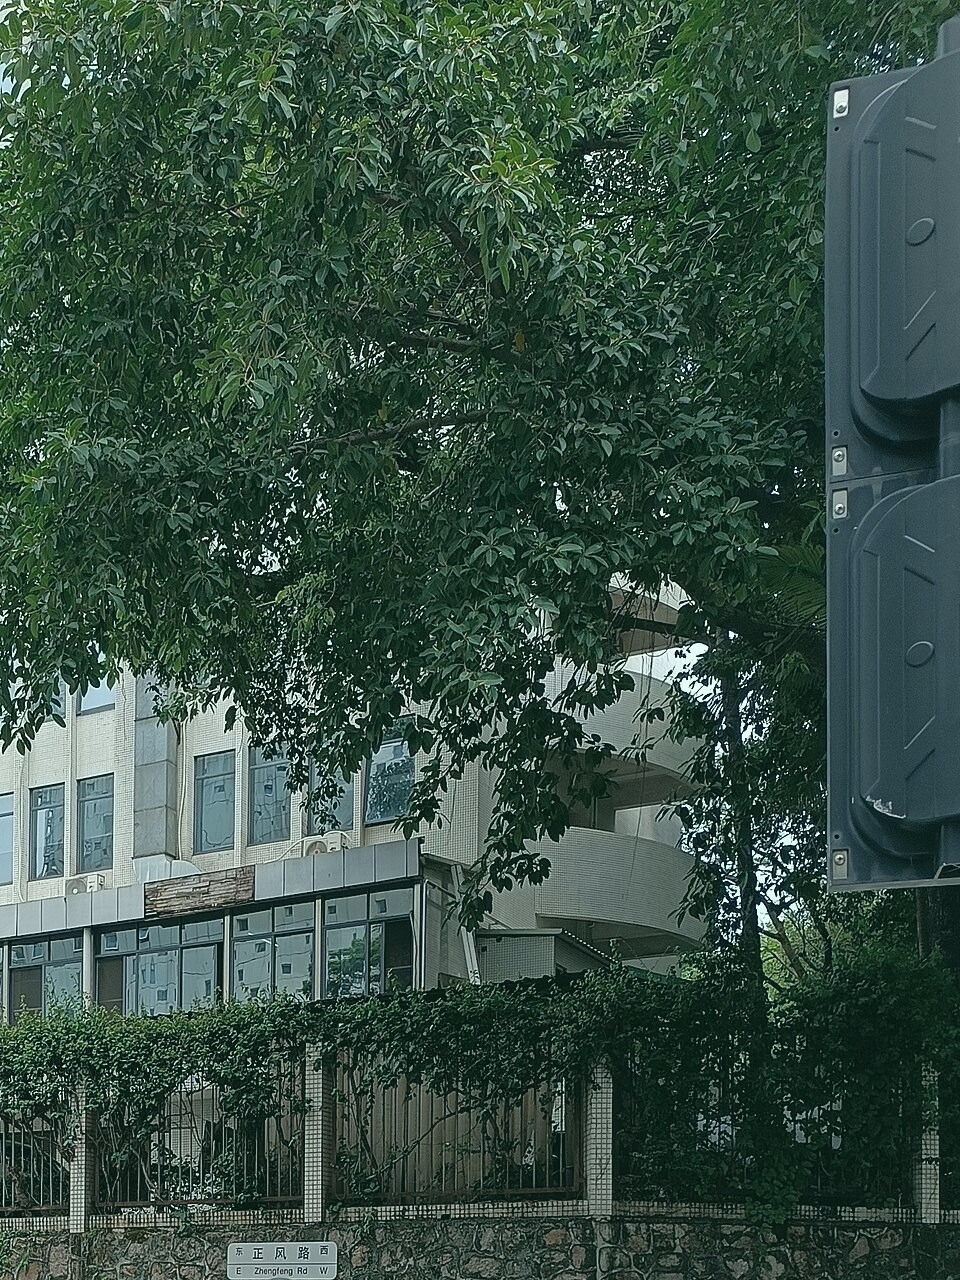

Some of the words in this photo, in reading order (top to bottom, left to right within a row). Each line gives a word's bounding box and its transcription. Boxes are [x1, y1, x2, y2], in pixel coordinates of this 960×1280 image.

[252, 1246, 310, 1260] 正风路
[320, 1245, 329, 1255] 西
[236, 1267, 242, 1275] E
[254, 1267, 294, 1276] Zhengfeng
[297, 1267, 308, 1275] Rd
[319, 1267, 328, 1275] W
